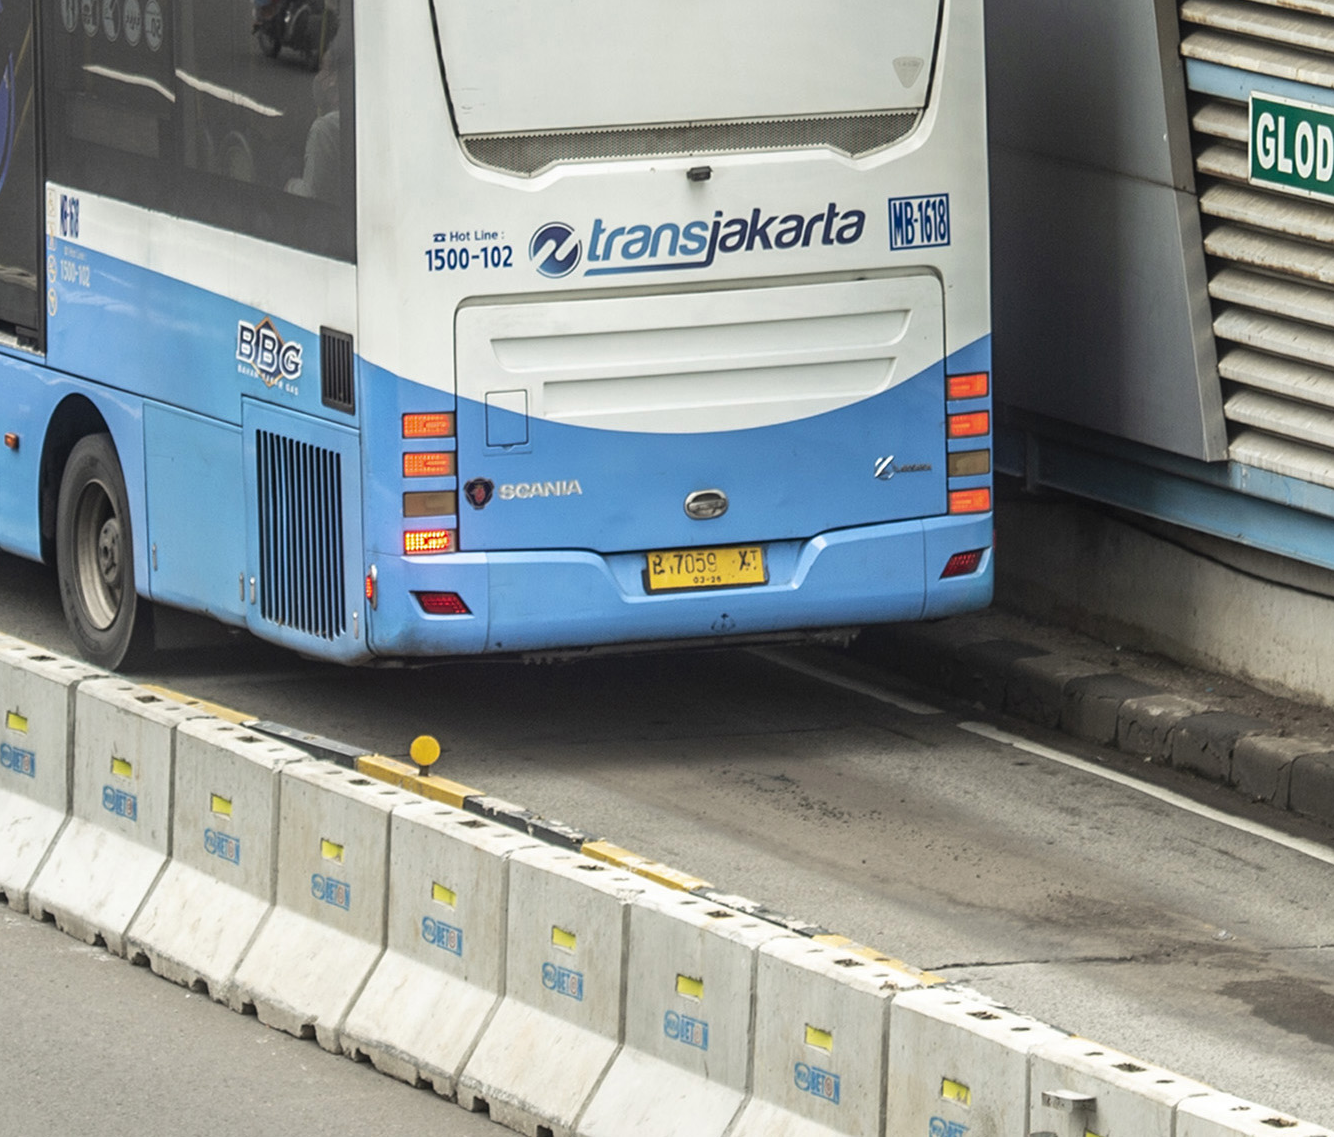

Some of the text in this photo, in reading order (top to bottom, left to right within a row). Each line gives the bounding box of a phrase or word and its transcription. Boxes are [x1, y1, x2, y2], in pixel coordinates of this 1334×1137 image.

[893, 198, 947, 246] MB-1618
[450, 231, 471, 242] Hot
[474, 230, 498, 241] Line
[584, 203, 866, 277] transjakarta
[425, 245, 513, 271] 1500-102
[236, 320, 303, 380] BBG
[498, 479, 582, 500] SCANIA
[653, 555, 665, 575] B
[674, 552, 717, 574] 7059
